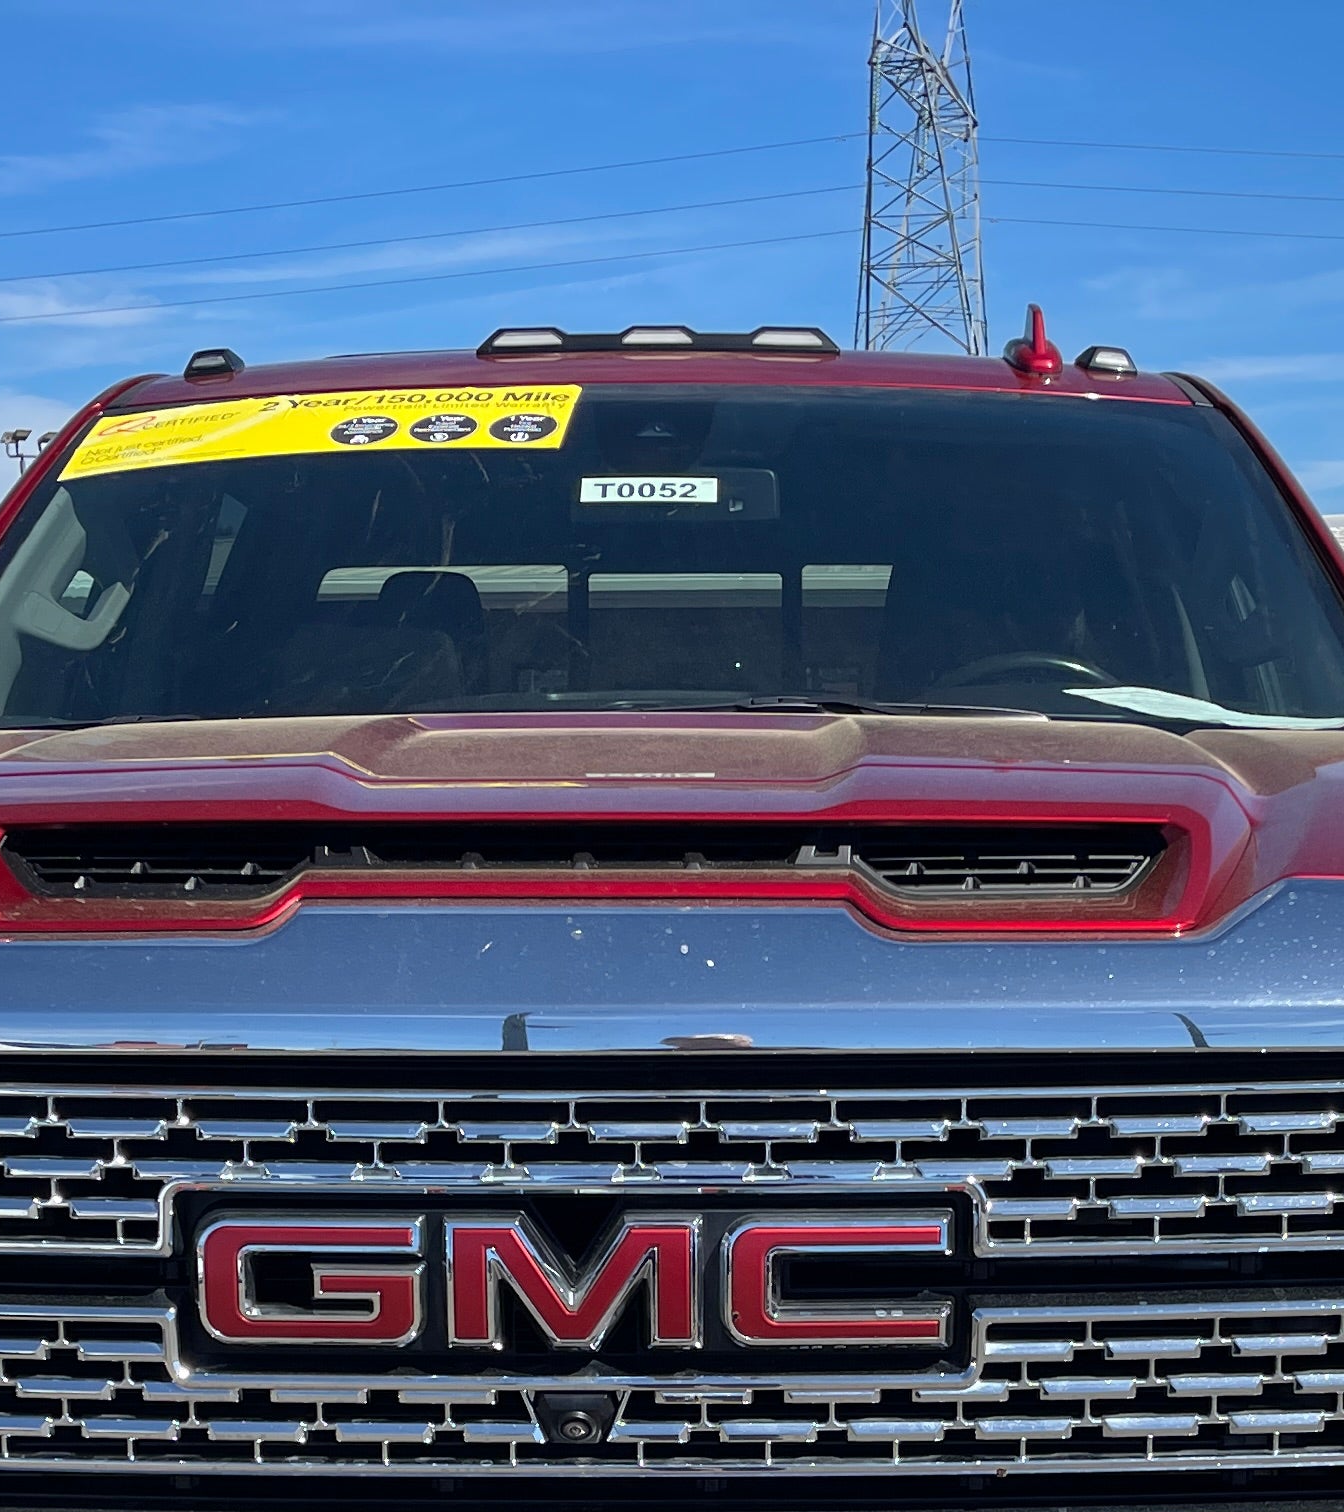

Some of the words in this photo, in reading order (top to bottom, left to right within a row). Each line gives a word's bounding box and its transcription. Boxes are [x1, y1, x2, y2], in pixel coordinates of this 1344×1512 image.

[258, 401, 280, 412] 2
[503, 391, 570, 402] Mile
[343, 401, 427, 412] Powertrain
[433, 400, 490, 409] Limited
[495, 401, 566, 409] Warranty
[85, 446, 112, 458] Not
[114, 441, 142, 454] just
[594, 482, 697, 499] T0052
[197, 1208, 955, 1349] GMC
